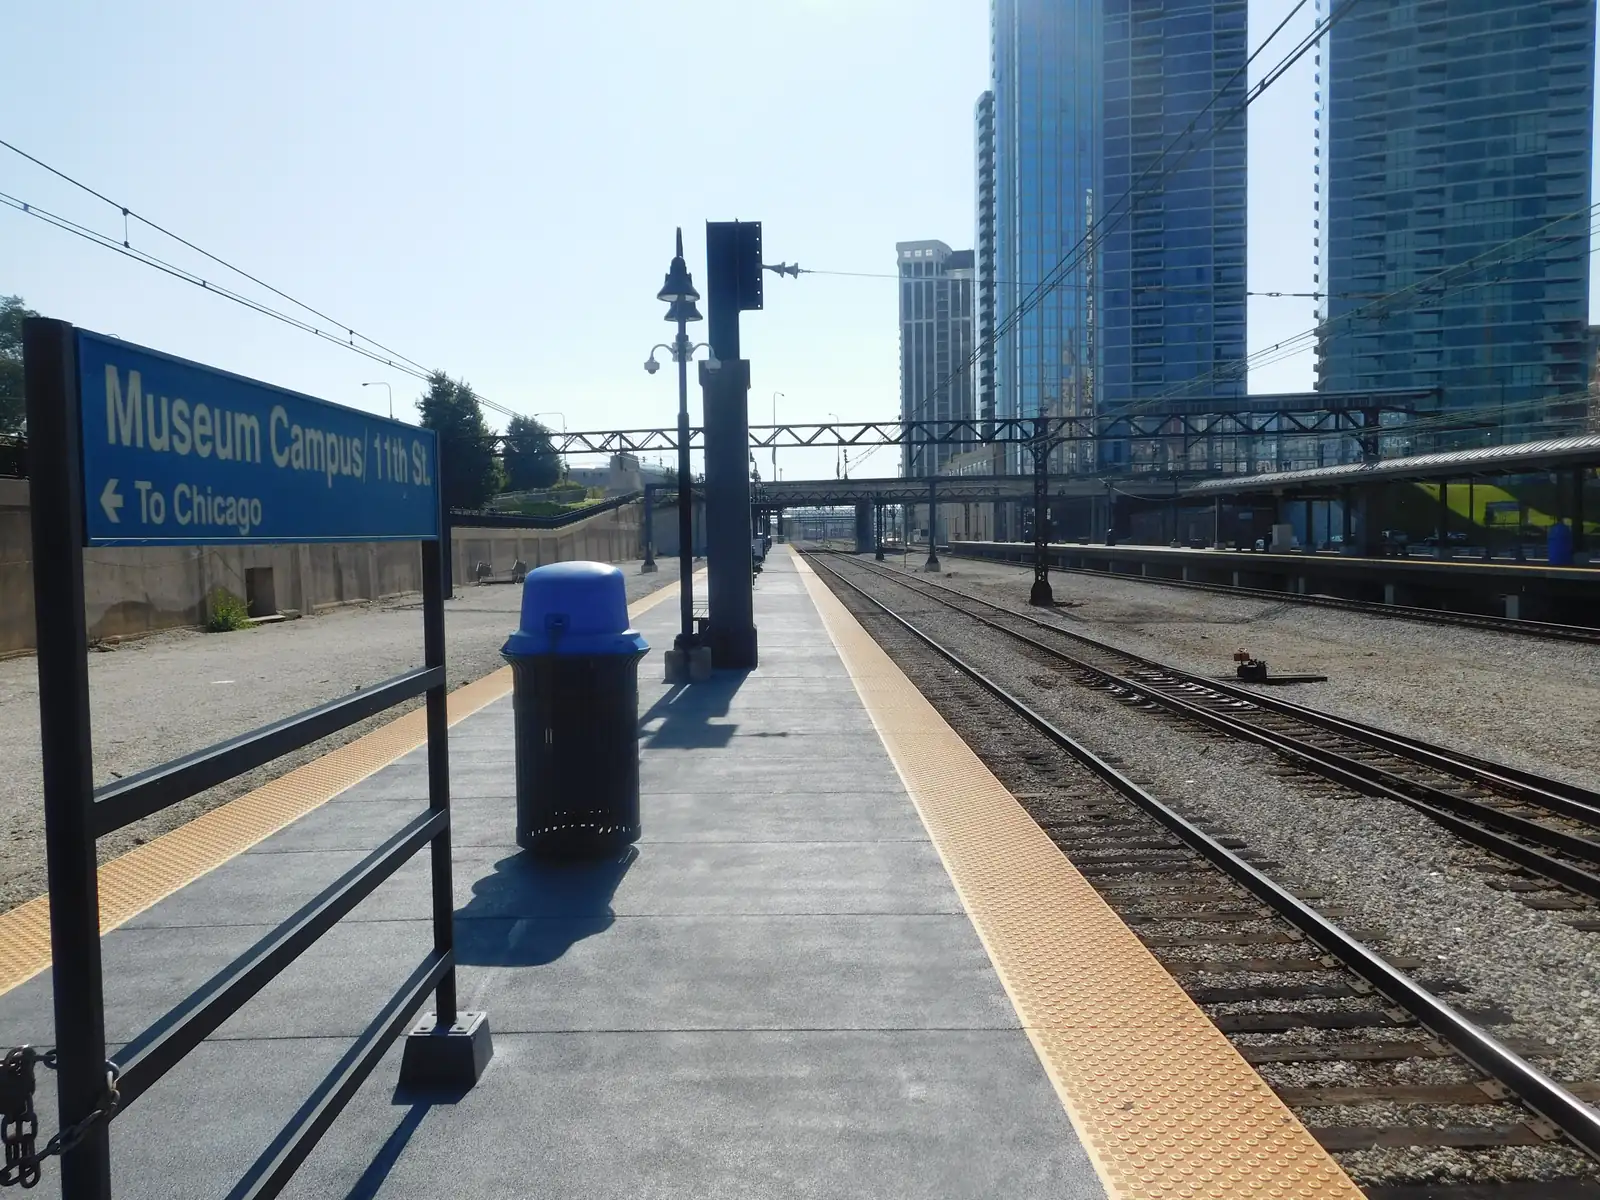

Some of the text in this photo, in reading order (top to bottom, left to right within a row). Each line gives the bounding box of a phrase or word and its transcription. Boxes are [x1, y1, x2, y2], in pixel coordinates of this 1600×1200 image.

[105, 363, 432, 489] Museum Campus/ 11th St.
[134, 480, 262, 536] To Chicago
